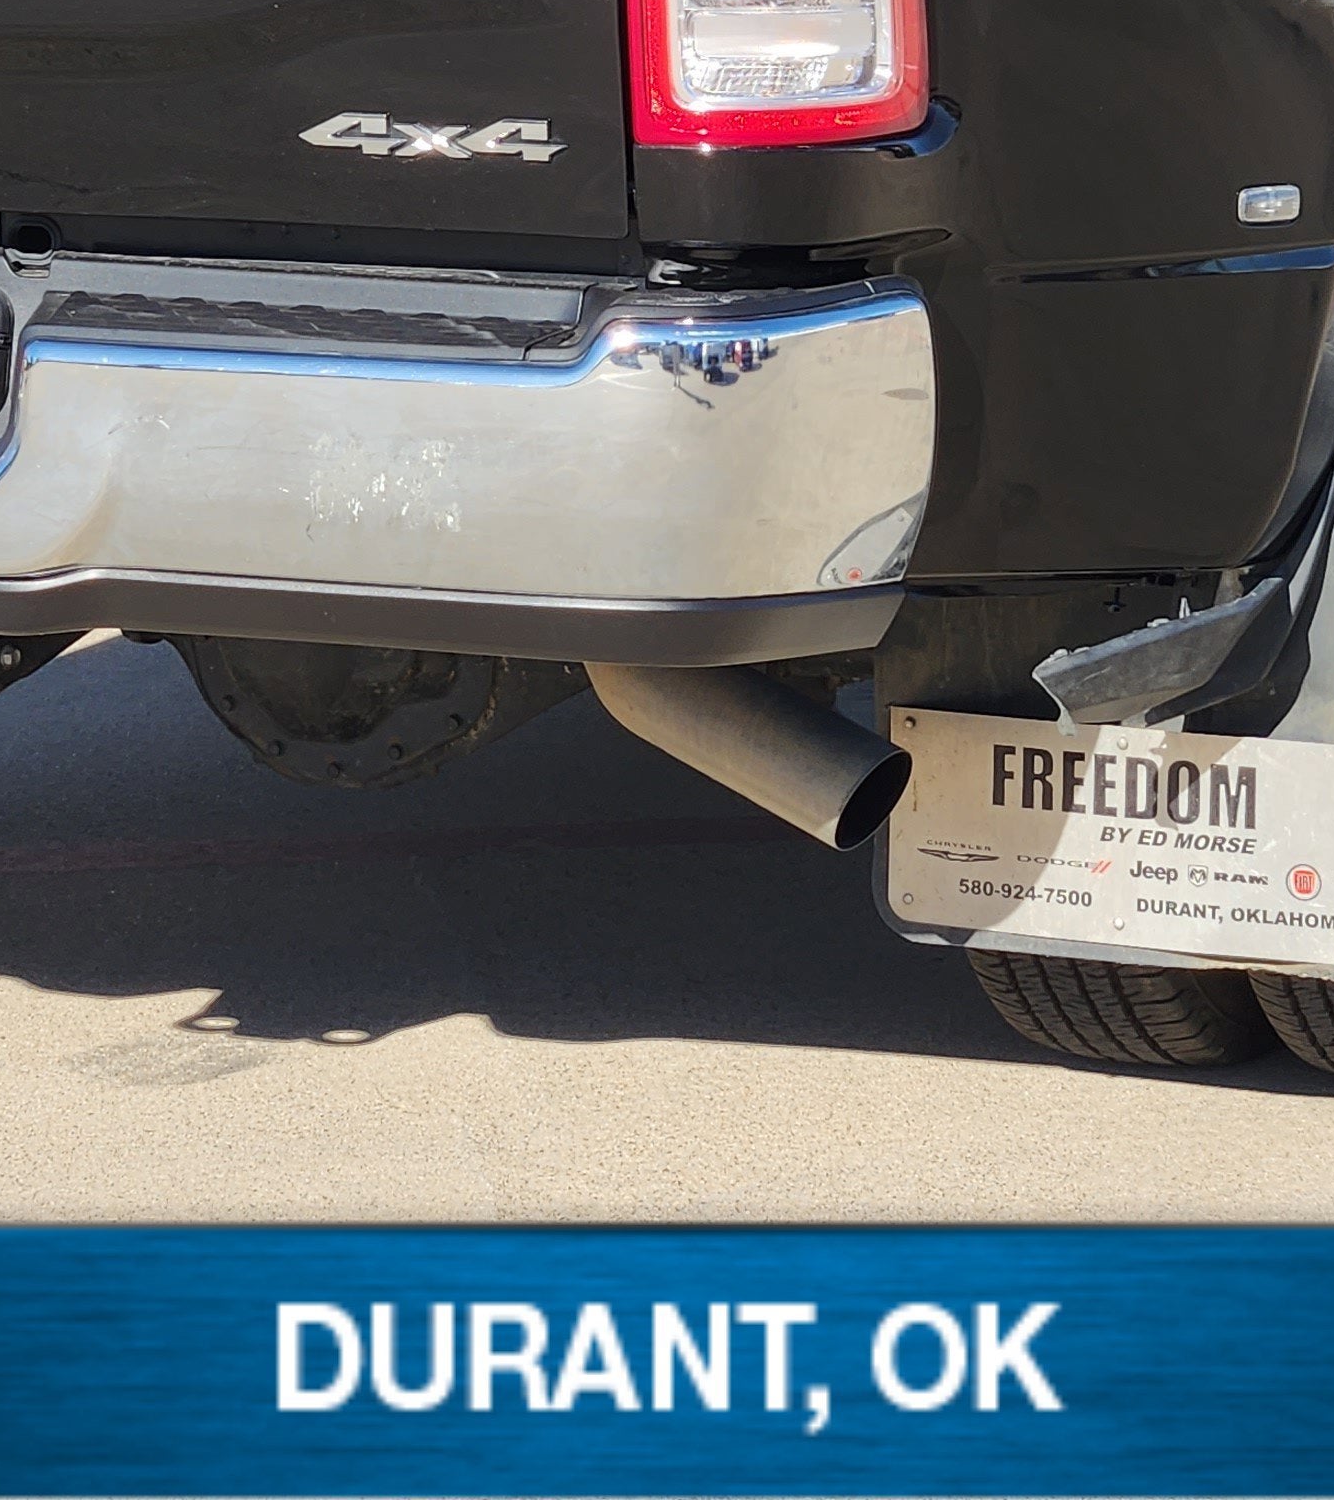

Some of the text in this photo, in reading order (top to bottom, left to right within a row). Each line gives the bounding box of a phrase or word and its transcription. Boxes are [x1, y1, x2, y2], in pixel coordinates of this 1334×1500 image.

[298, 111, 569, 163] 4x4
[992, 744, 1257, 829] FREEDOM
[926, 838, 992, 852] CHRYSLER
[1100, 826, 1258, 855] BY ED MORSE
[1129, 860, 1179, 884] Jeep
[1214, 871, 1269, 886] RAM
[959, 877, 1093, 908] 580-924-7500
[1136, 898, 1224, 924] DURANT,
